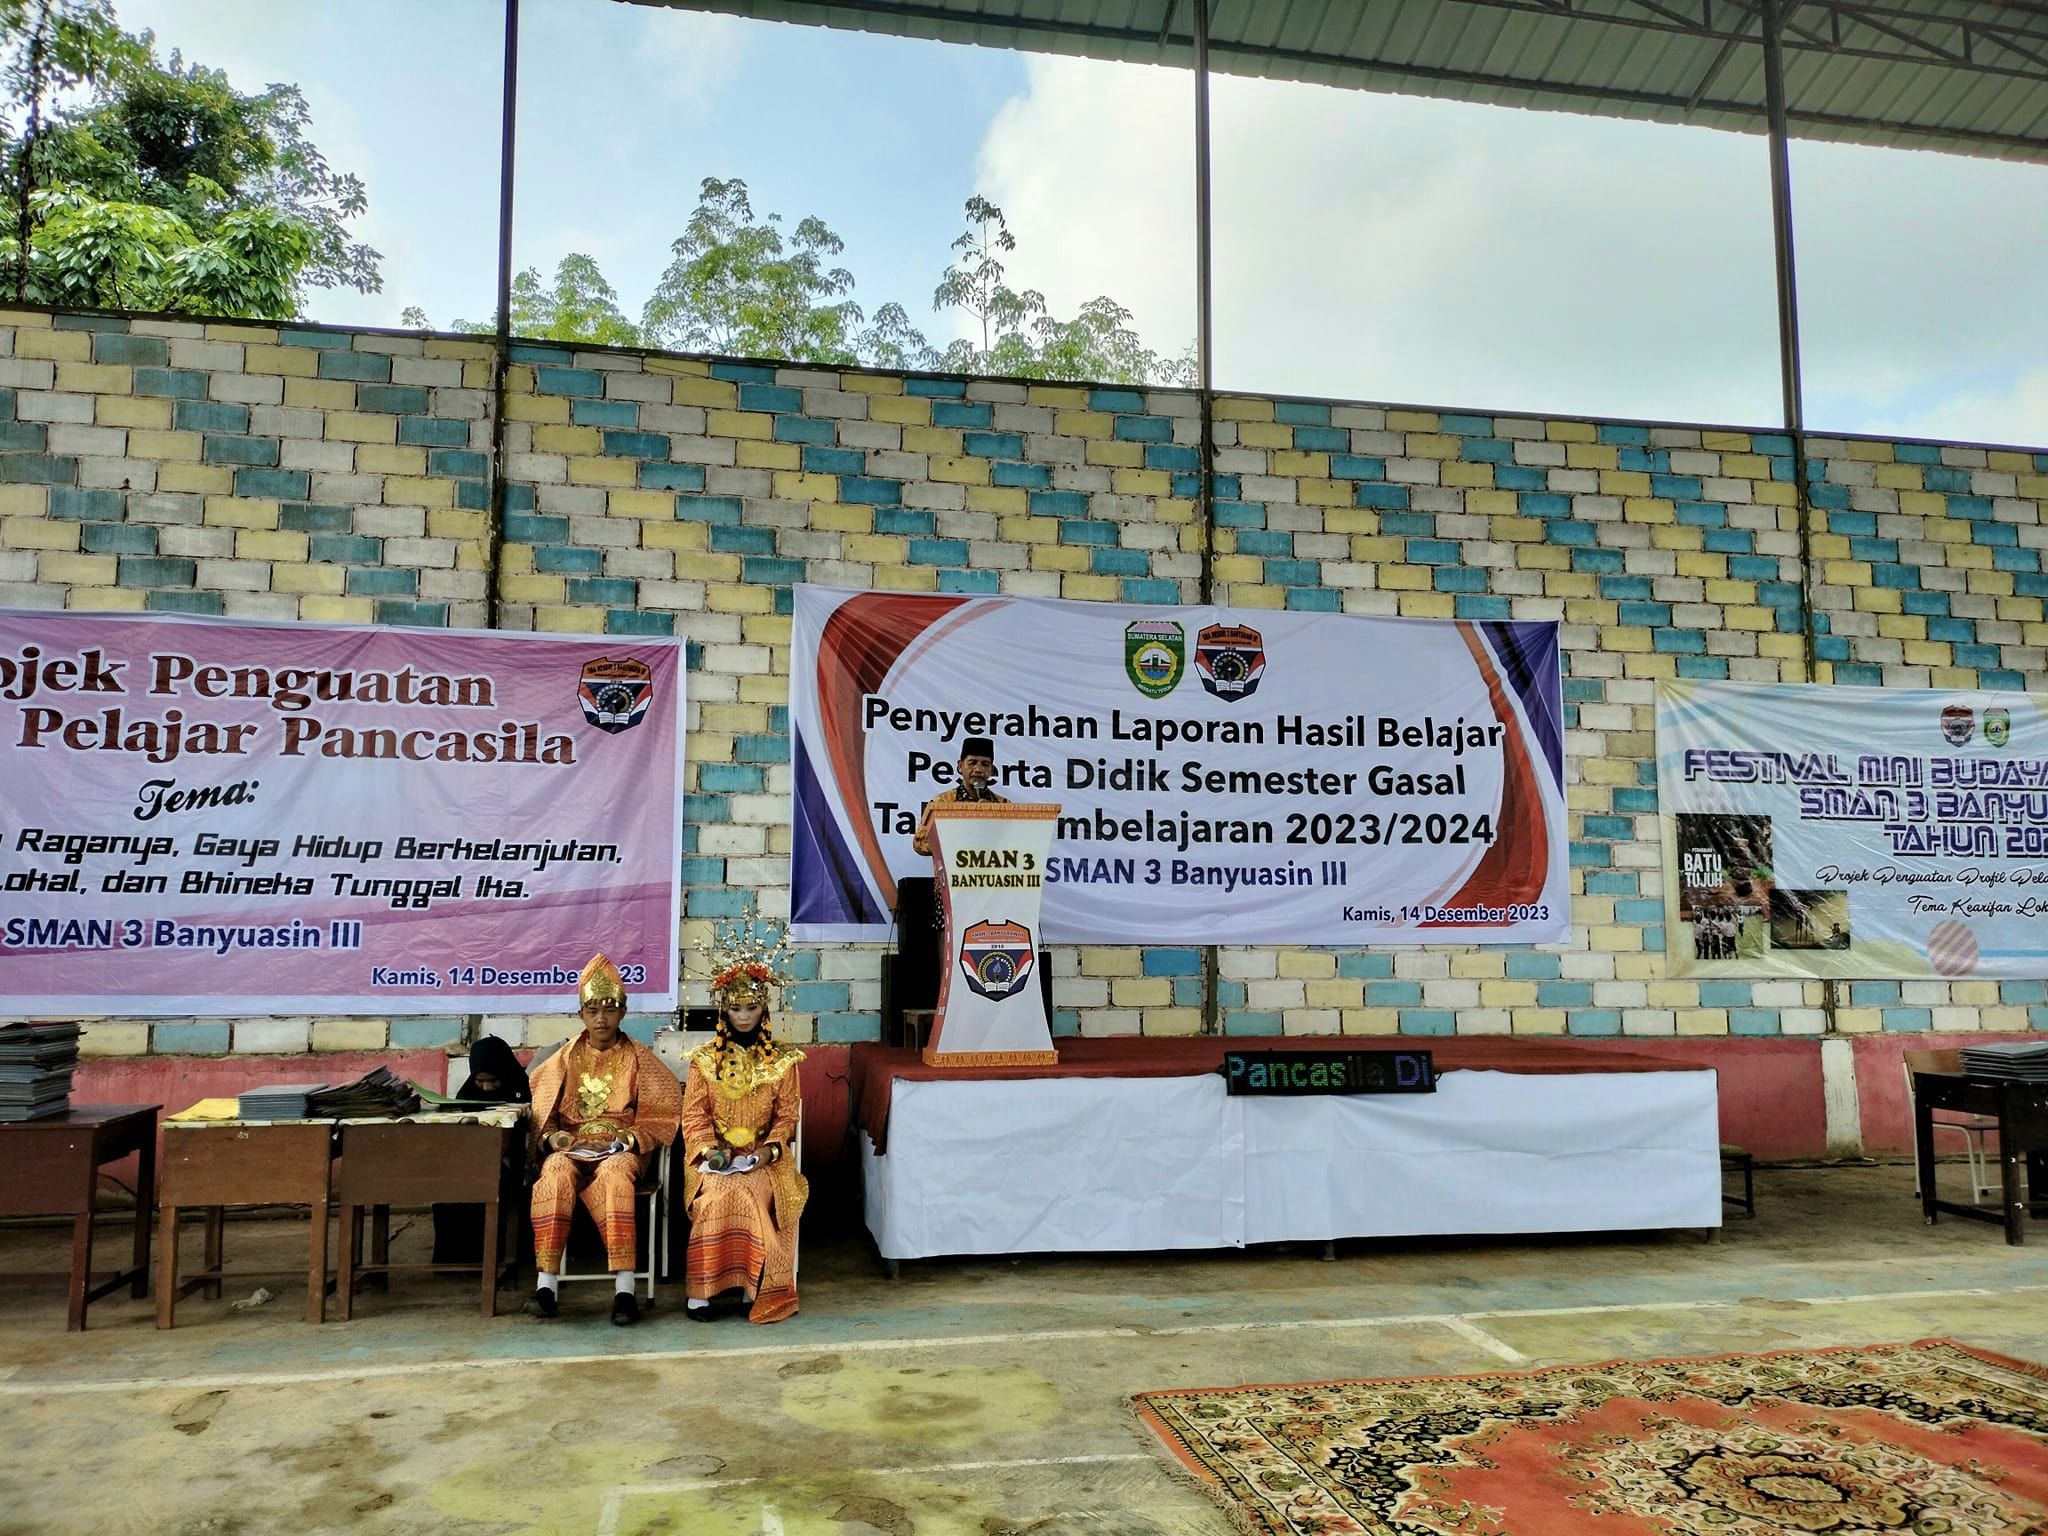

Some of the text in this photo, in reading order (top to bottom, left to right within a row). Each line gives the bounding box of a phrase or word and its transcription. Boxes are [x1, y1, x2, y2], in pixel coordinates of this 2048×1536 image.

[150, 655, 495, 711] Penguatan
[16, 708, 576, 764] Pelajar Pancasila
[865, 698, 1502, 756] Penyerahan Laporan Hasil Belajar
[908, 751, 1465, 796] Perta Didik Semester Gasal
[1685, 749, 1851, 785] FESTIVAL
[134, 778, 259, 820] Tema:
[1800, 788, 1898, 821] SMAN
[1907, 791, 1929, 822] 3
[1057, 809, 1494, 851] mbelajaran 2023/2024
[1884, 825, 1998, 857] TAHUN
[16, 829, 623, 871] Raganya, Gaya Hidup Berkelanjutan,
[956, 850, 1035, 870] SMAN 3
[1684, 853, 1721, 872] BATU
[0, 869, 529, 908] okal, dan Bhineka Tunggal Ika.
[952, 874, 1040, 887] BANYUASIN III
[1045, 857, 1347, 892] SMAN 3 Banyuasin III
[1685, 872, 1723, 887] TUJUH
[1816, 865, 1869, 888] Projek
[1873, 866, 1953, 886] Penguatan
[1957, 868, 2006, 888] Profil
[1343, 905, 1549, 923] Kamis, 14 Desember 2023
[1908, 895, 1947, 914] Tema
[1951, 897, 2012, 917] Kearifan
[5, 918, 359, 954] SMAN 3 Banyuasin III
[372, 967, 441, 987] Kamis,
[449, 968, 474, 985] 14
[481, 967, 580, 985] Desembe
[1228, 1055, 1430, 1088] Pancasila Di
